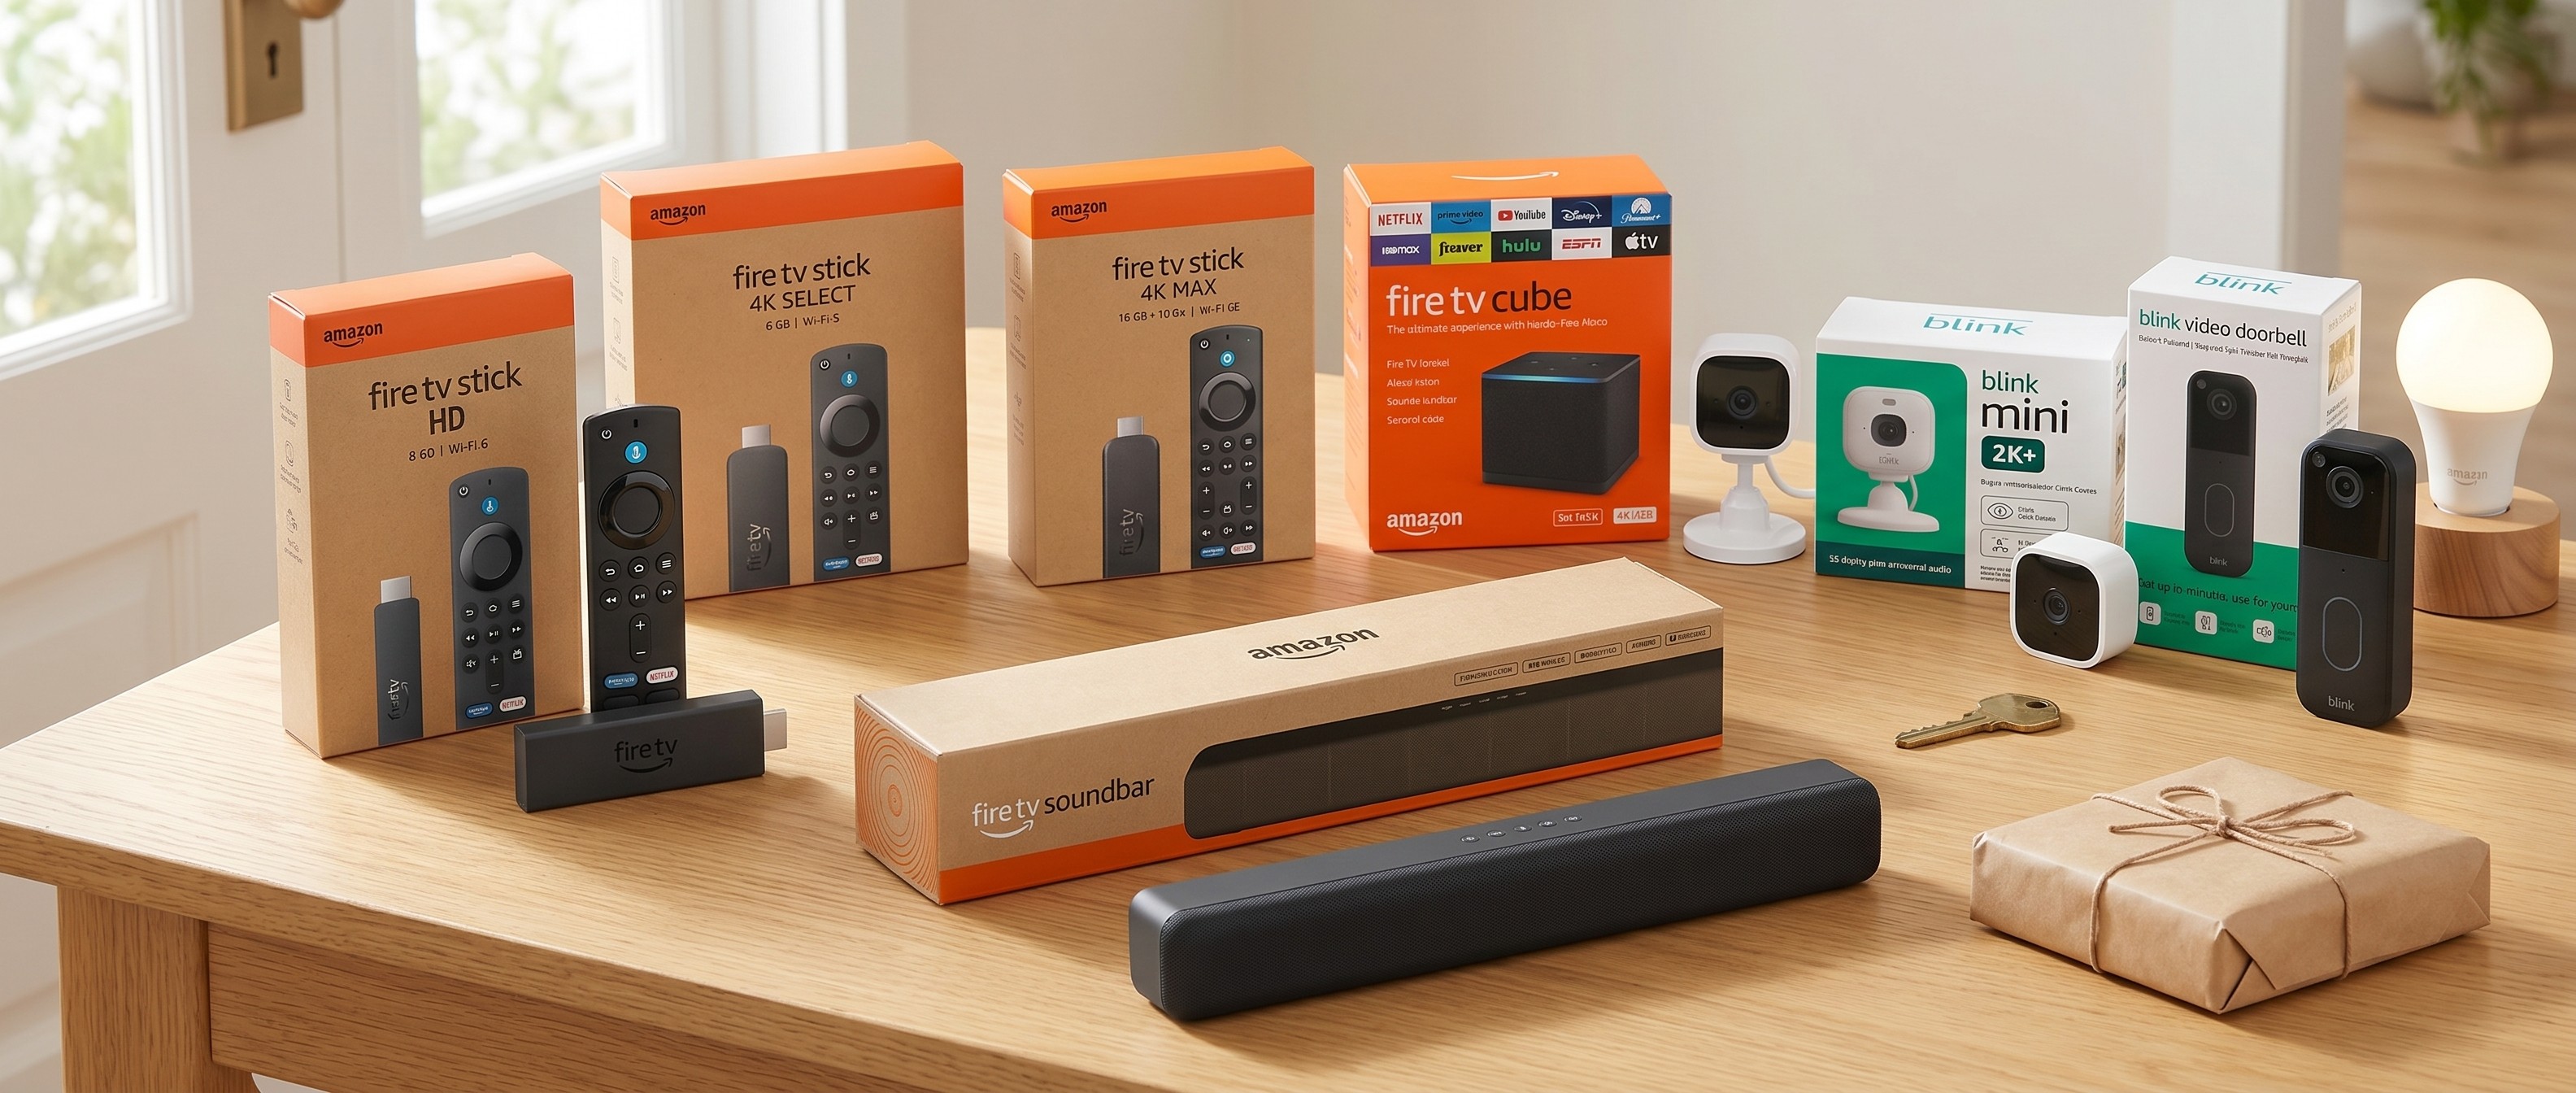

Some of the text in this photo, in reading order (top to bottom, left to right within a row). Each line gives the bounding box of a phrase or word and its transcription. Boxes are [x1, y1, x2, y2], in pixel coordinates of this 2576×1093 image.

[650, 204, 706, 220] amazon
[1051, 201, 1107, 219] amazon
[1377, 213, 1423, 227] NETFLIX
[1438, 210, 1484, 220] prime video
[1502, 238, 1541, 253] hulu
[1562, 237, 1601, 250] ESPN
[1640, 234, 1660, 249] tv
[733, 253, 871, 290] fire tv stick
[1112, 246, 1245, 281] fire tv stick
[1140, 279, 1217, 302] 4K MAX
[2195, 274, 2285, 294] blink
[749, 285, 856, 312] 4K SELECT
[1386, 281, 1572, 317] fire tv cube
[766, 320, 772, 330] 6
[776, 319, 790, 329] GB
[1119, 312, 1130, 322] 16
[1134, 311, 1147, 321] GB
[1158, 309, 1170, 319] 10
[323, 322, 383, 343] amazon
[1386, 324, 1405, 334] The
[1503, 320, 1525, 330] with
[1923, 316, 2028, 336] blink
[2139, 308, 2308, 347] blink video doorbell
[1386, 359, 1404, 368] Fire
[1405, 359, 1417, 368] TV
[368, 360, 522, 411] fire tv stick
[1982, 369, 2039, 394] blink
[429, 405, 465, 435] HD
[1981, 397, 2069, 433] mini
[408, 451, 416, 461] 8
[1992, 443, 2037, 464] 2K+
[1386, 511, 1463, 529] amazon
[1928, 565, 1952, 574] audio
[2157, 583, 2171, 594] up
[2232, 594, 2250, 605] use
[2253, 595, 2269, 607] for
[1248, 625, 1380, 660] amazon
[2328, 695, 2355, 712] blink
[614, 738, 678, 763] fire tv
[972, 777, 1155, 827] fire tv soundbar
